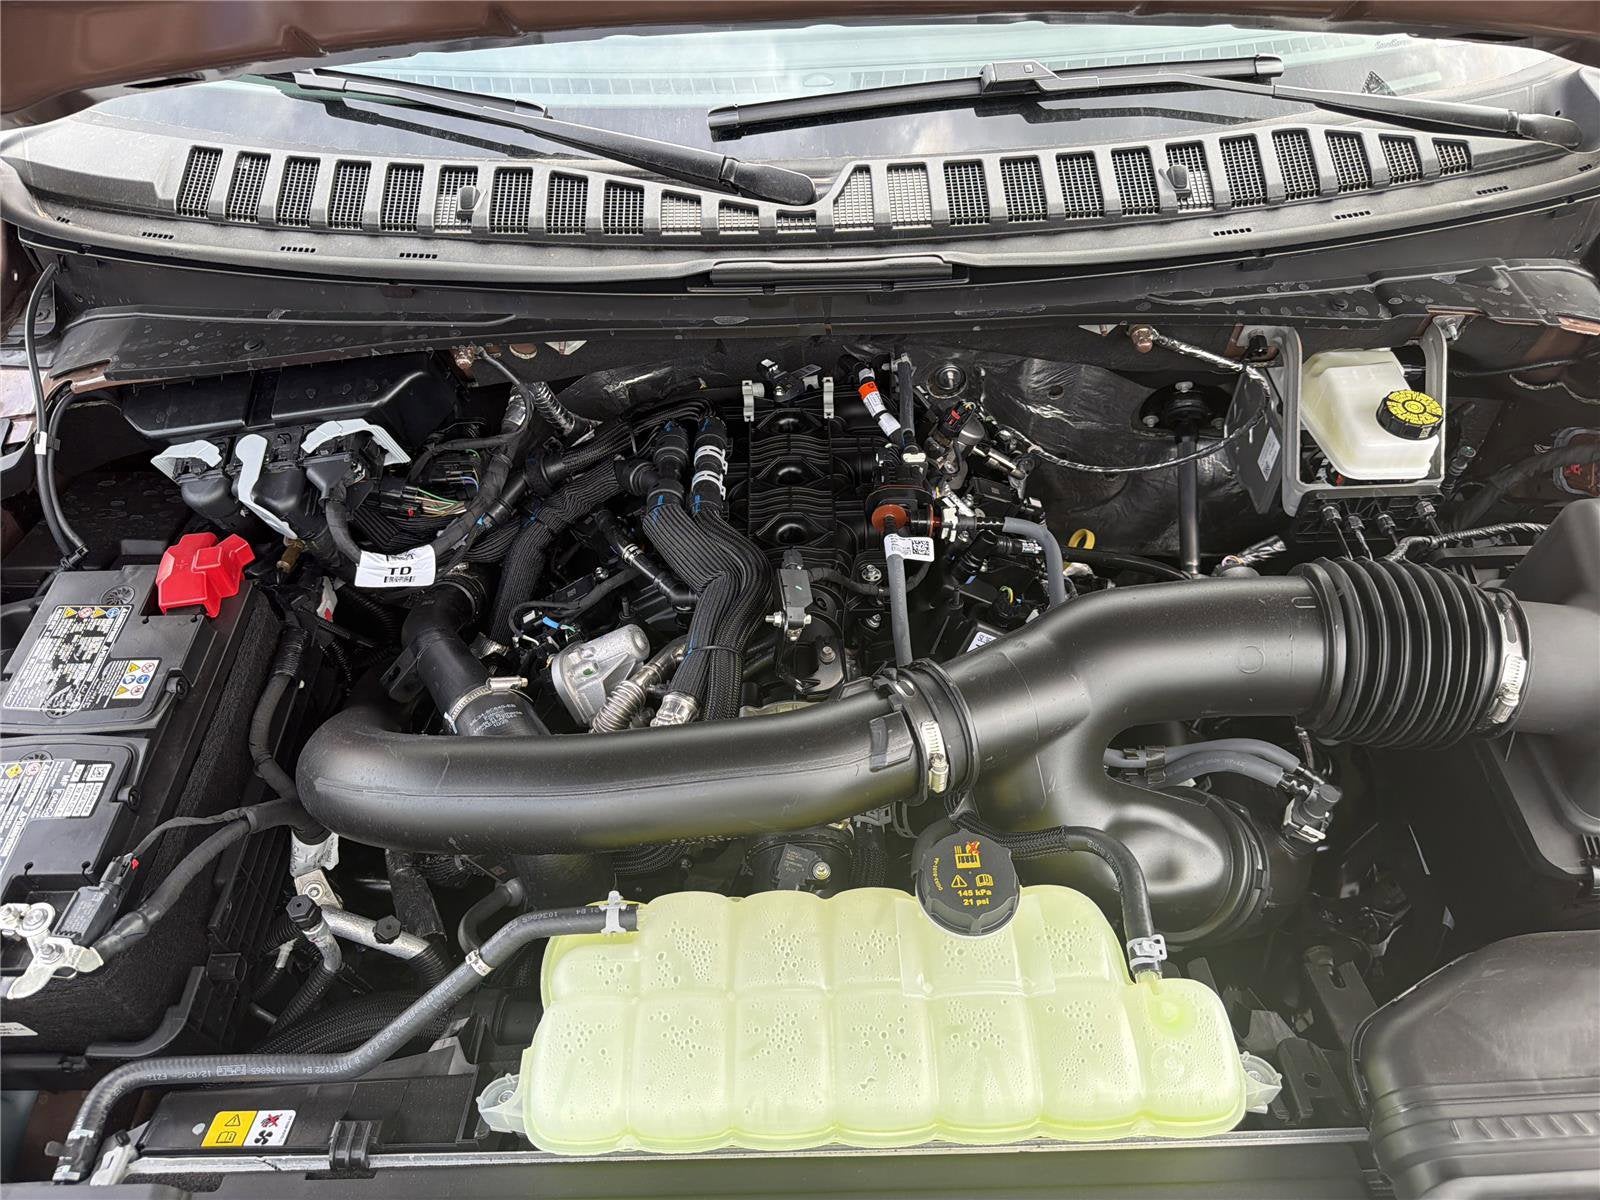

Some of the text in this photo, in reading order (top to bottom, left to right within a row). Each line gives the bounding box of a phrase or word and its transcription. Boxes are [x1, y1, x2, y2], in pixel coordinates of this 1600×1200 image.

[387, 566, 412, 576] TD
[957, 889, 992, 897] 145 kPa
[963, 898, 990, 907] 21 psi
